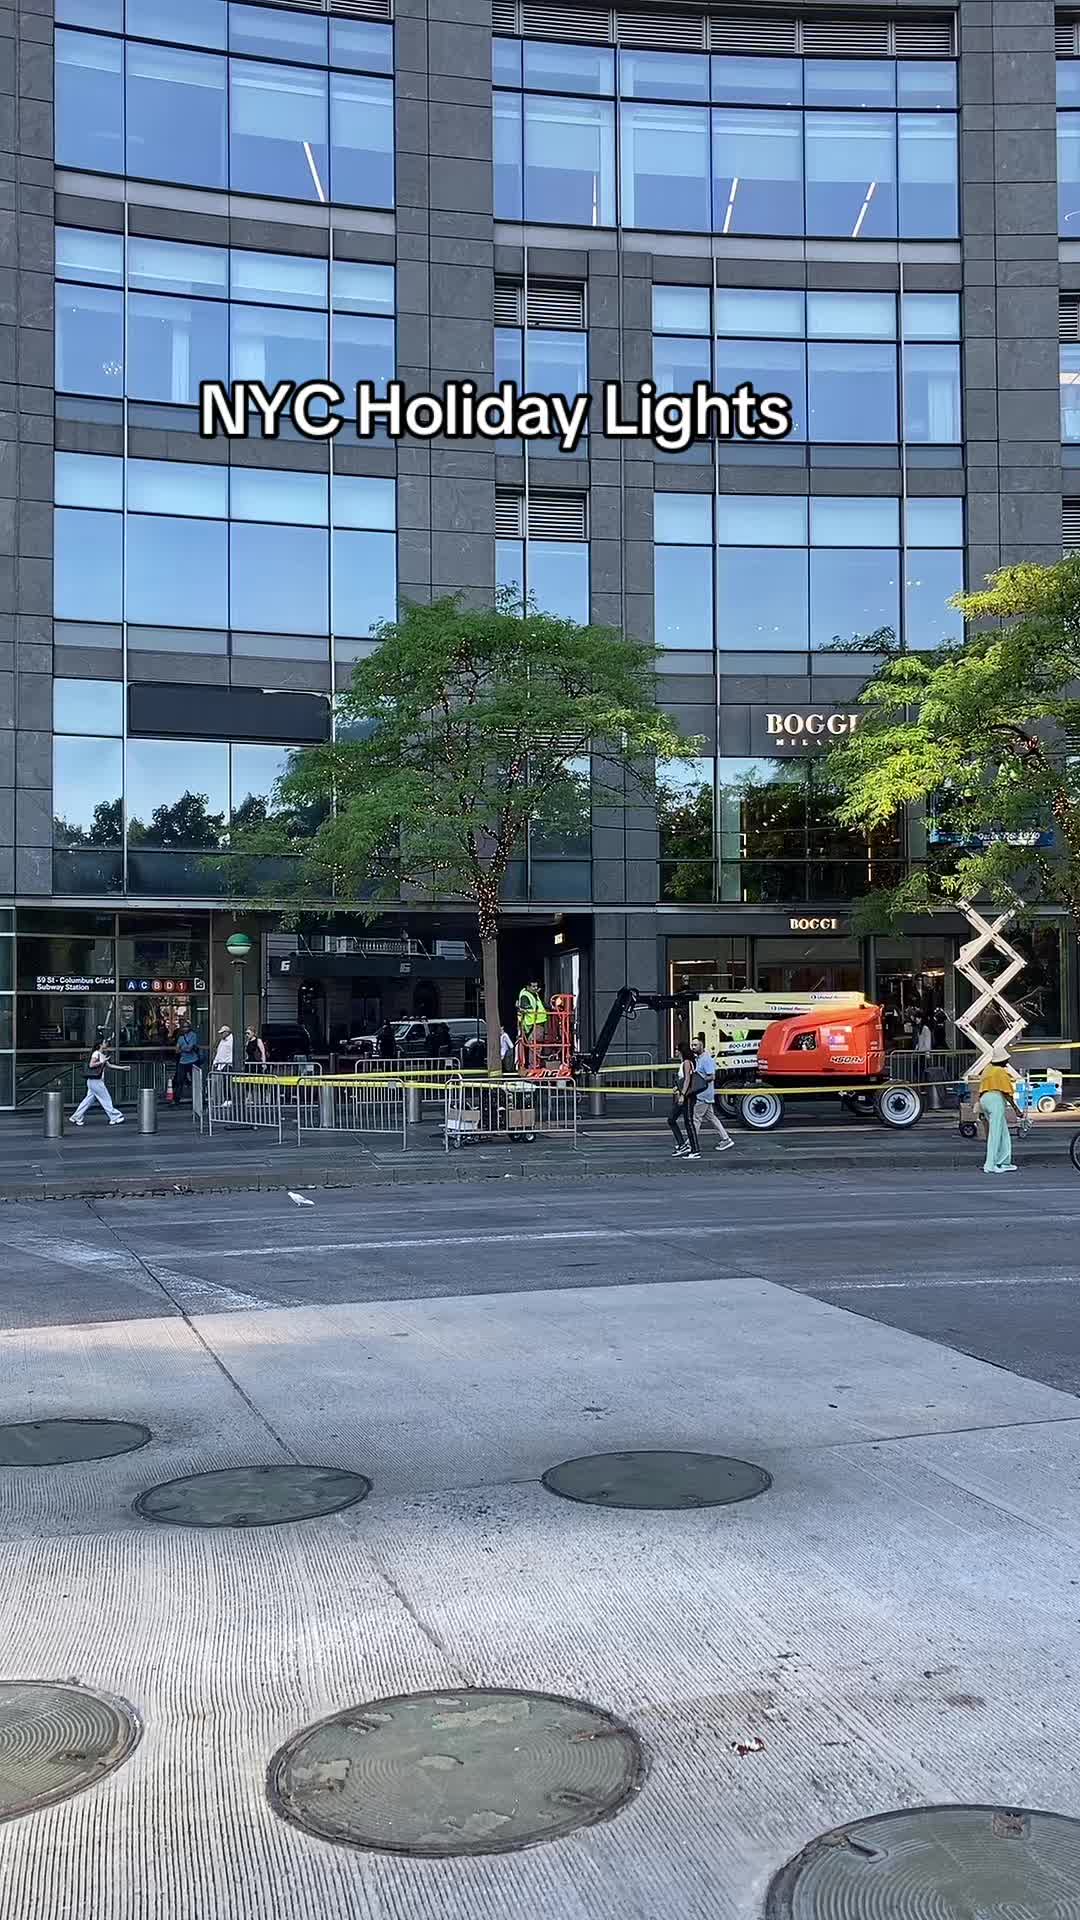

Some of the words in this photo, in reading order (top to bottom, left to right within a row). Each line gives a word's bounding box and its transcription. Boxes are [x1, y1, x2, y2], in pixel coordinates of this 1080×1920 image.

[766, 713, 858, 734] BOGGI
[789, 918, 837, 929] BOGGI
[36, 976, 46, 984] 59
[47, 976, 55, 984] St
[59, 976, 94, 984] Columbus
[94, 976, 115, 985] Circle
[36, 984, 64, 992] Subway
[127, 981, 135, 990] A
[141, 981, 148, 990] C
[153, 981, 161, 990] B
[166, 981, 174, 990] D
